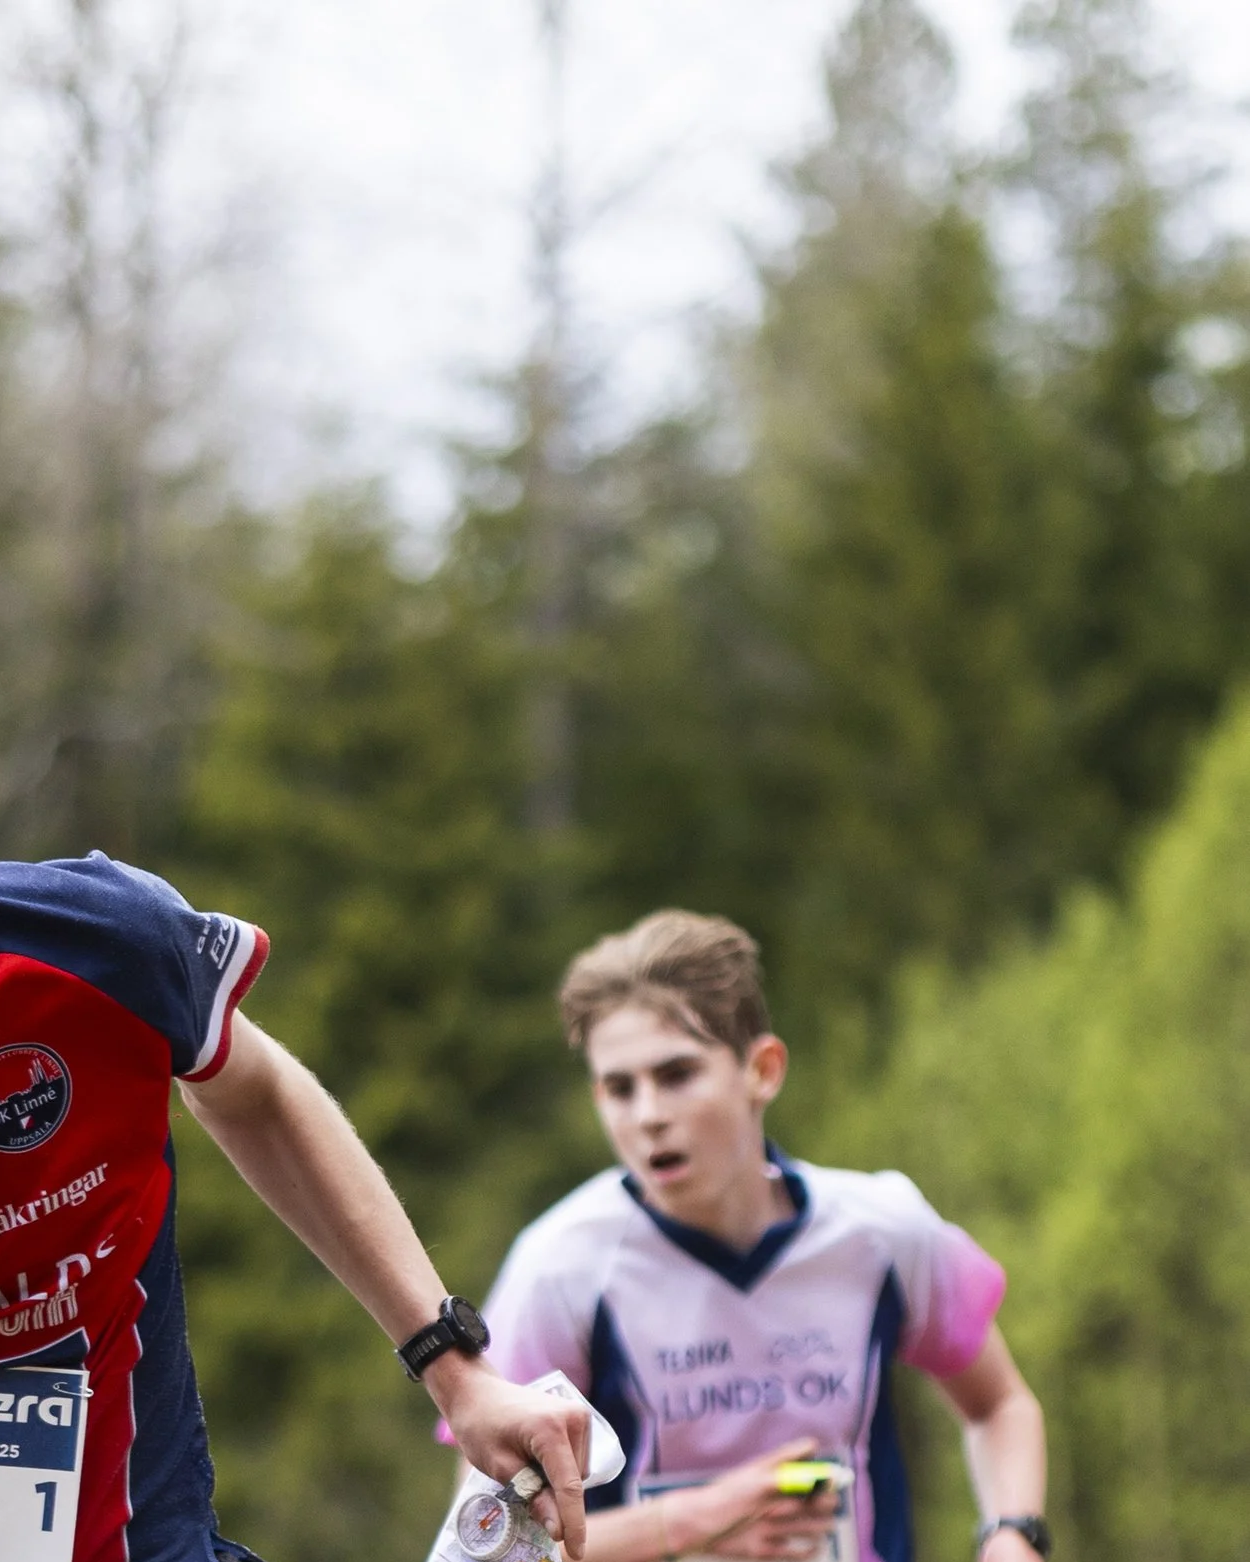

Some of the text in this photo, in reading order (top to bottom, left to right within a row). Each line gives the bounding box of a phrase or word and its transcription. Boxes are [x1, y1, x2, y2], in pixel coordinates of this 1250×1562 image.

[14, 1087, 58, 1116] Linné
[10, 1121, 53, 1145] UPPSALA
[661, 1372, 848, 1423] LUNDS OK
[35, 1481, 57, 1532] 1
